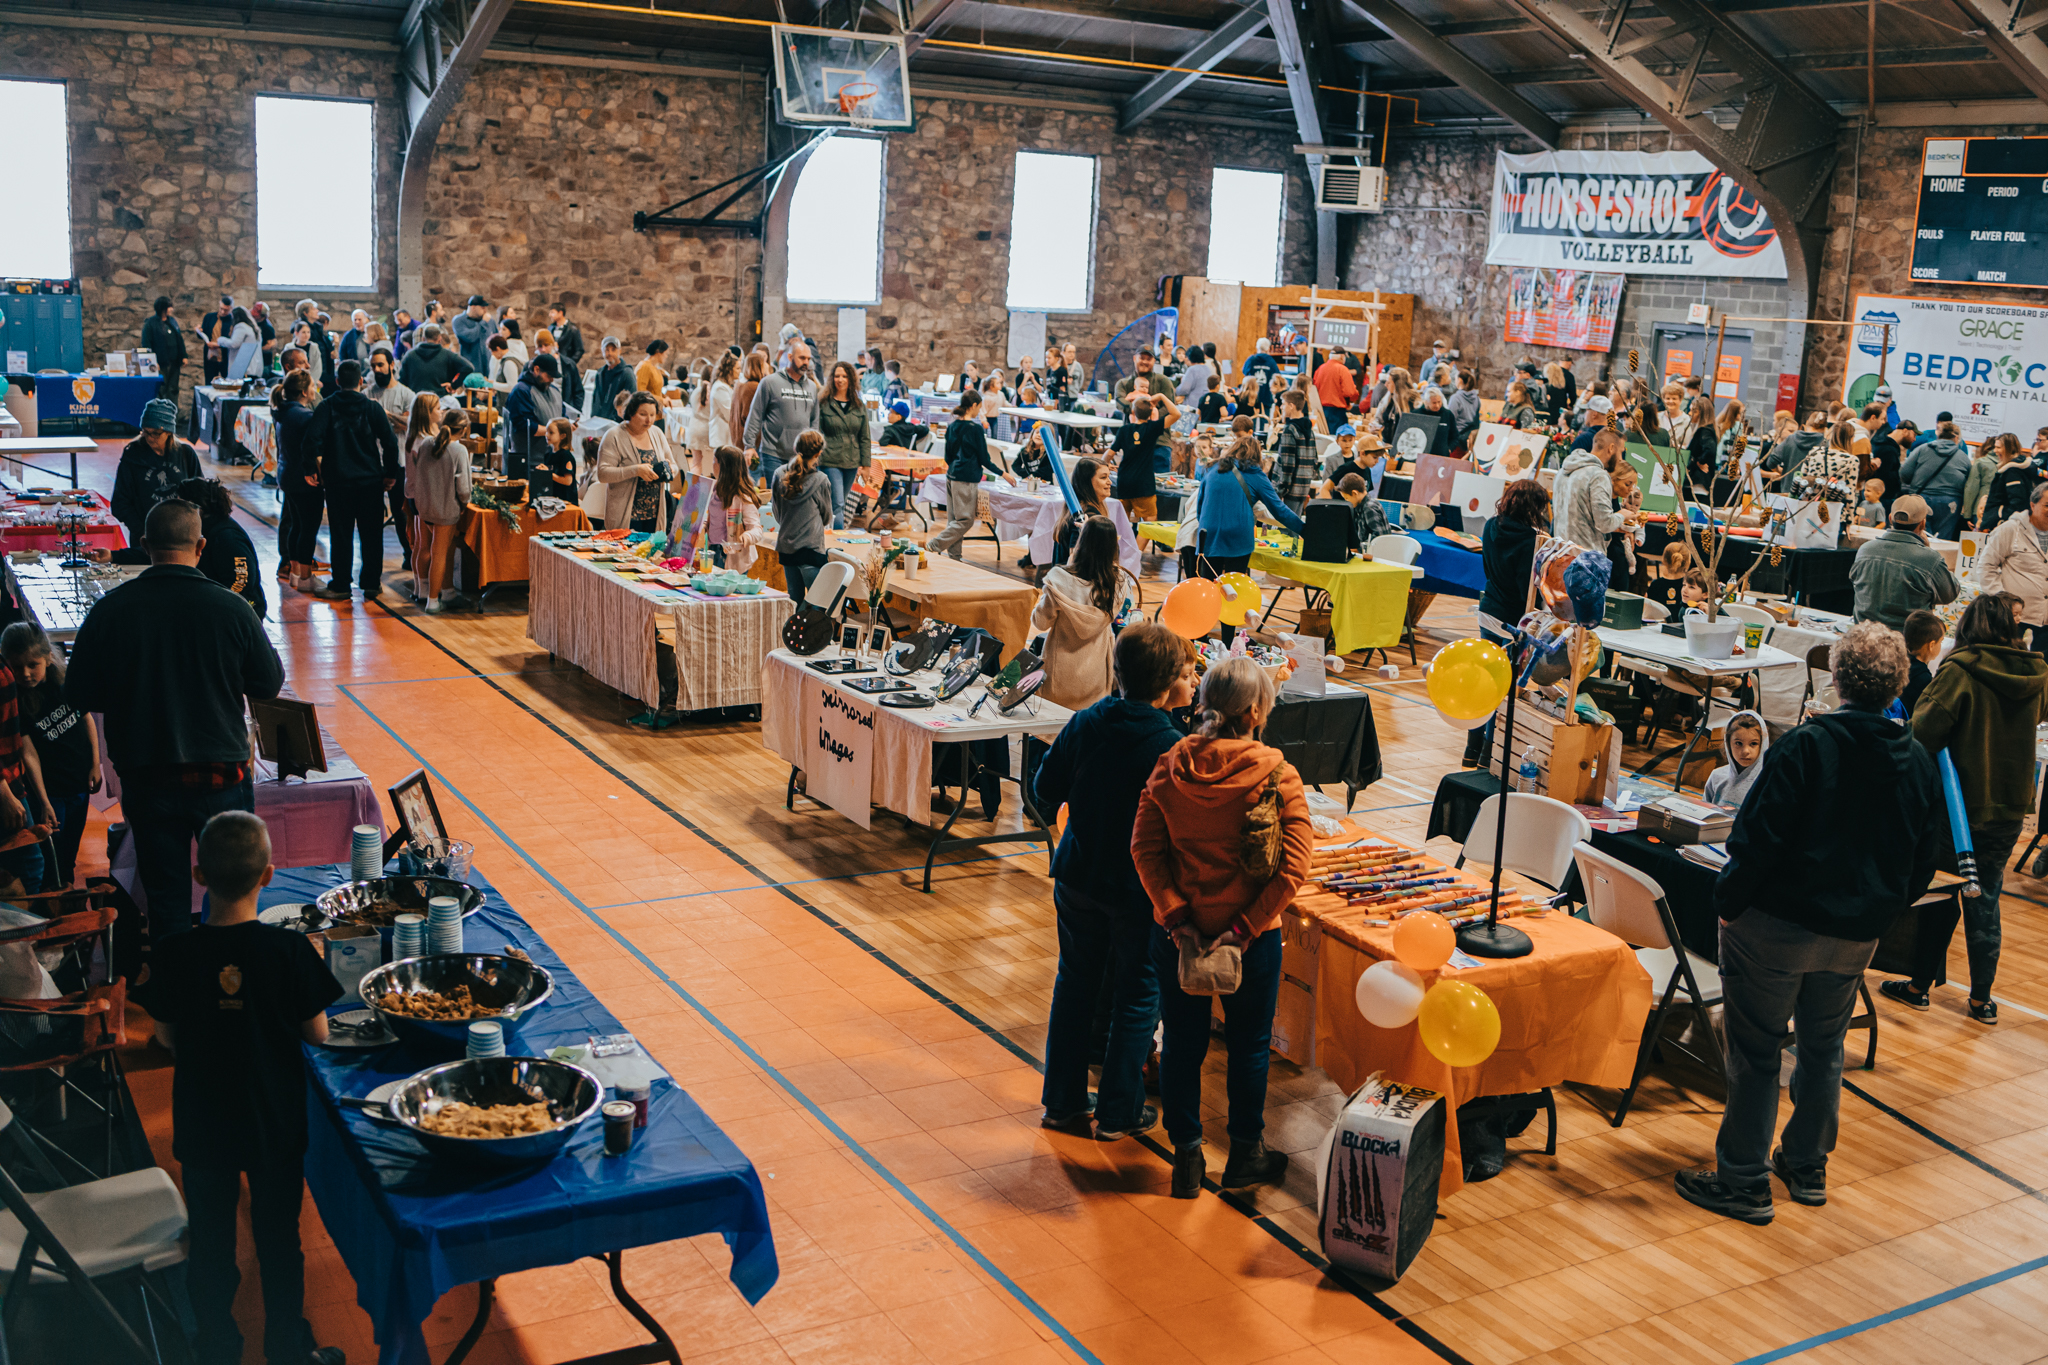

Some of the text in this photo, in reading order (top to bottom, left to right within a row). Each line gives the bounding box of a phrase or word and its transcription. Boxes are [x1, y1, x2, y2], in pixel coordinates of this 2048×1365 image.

[1930, 178, 1966, 192] HOME
[1987, 186, 2019, 197] PERIOD
[1520, 176, 1694, 234] HORSESHOE
[1917, 229, 1944, 239] FOULS
[1970, 231, 2026, 242] PLAYER FOUL
[1560, 240, 1693, 265] VOLLEYBALL
[1912, 267, 1939, 279] SCORE
[1977, 270, 2006, 281] MATCH
[1911, 302, 1936, 310] THANK
[1968, 306, 1983, 314] OUR
[1985, 307, 2038, 318] SCOREBOARD
[1323, 323, 1356, 335] ANTLER
[1959, 318, 2025, 340] GRACE
[1327, 334, 1350, 346] SHOP
[1919, 381, 2048, 402] ENVIRONMENTAL
[1592, 687, 1617, 696] ADVENTURE
[822, 689, 873, 730] mirrored
[819, 716, 854, 763] images
[1359, 1131, 1385, 1141] YOUTH
[1341, 1130, 1391, 1156] BLOCK
